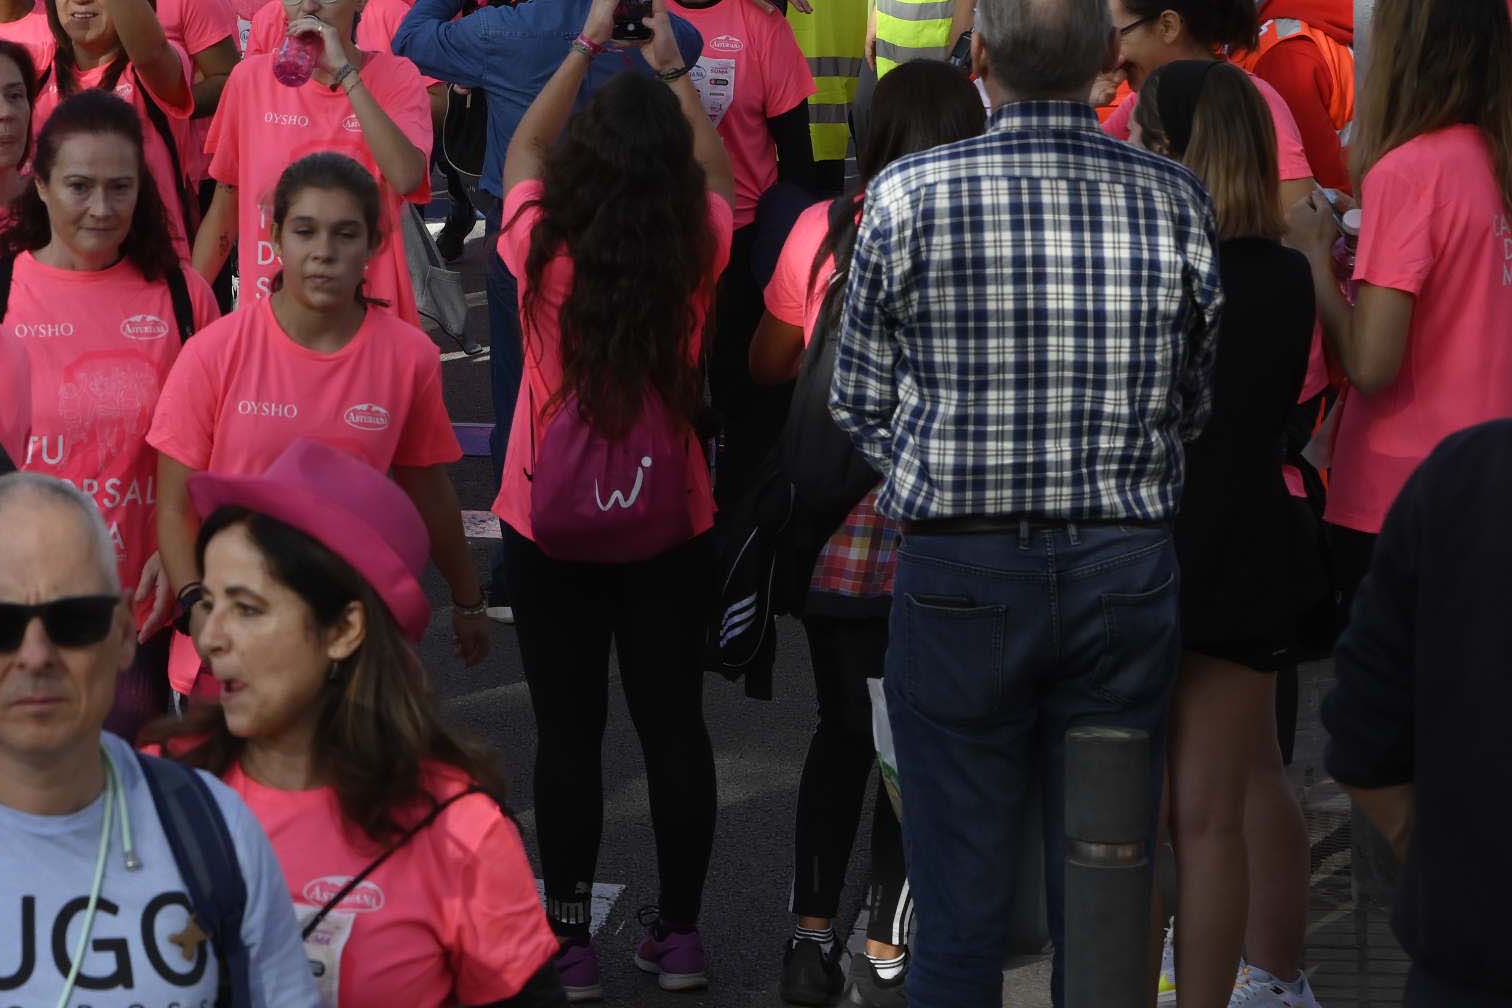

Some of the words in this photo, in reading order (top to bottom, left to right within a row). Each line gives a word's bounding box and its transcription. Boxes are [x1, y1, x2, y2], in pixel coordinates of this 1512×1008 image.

[265, 112, 309, 128] OYSHO
[15, 323, 75, 338] OYSHO
[238, 400, 298, 419] OYSHO
